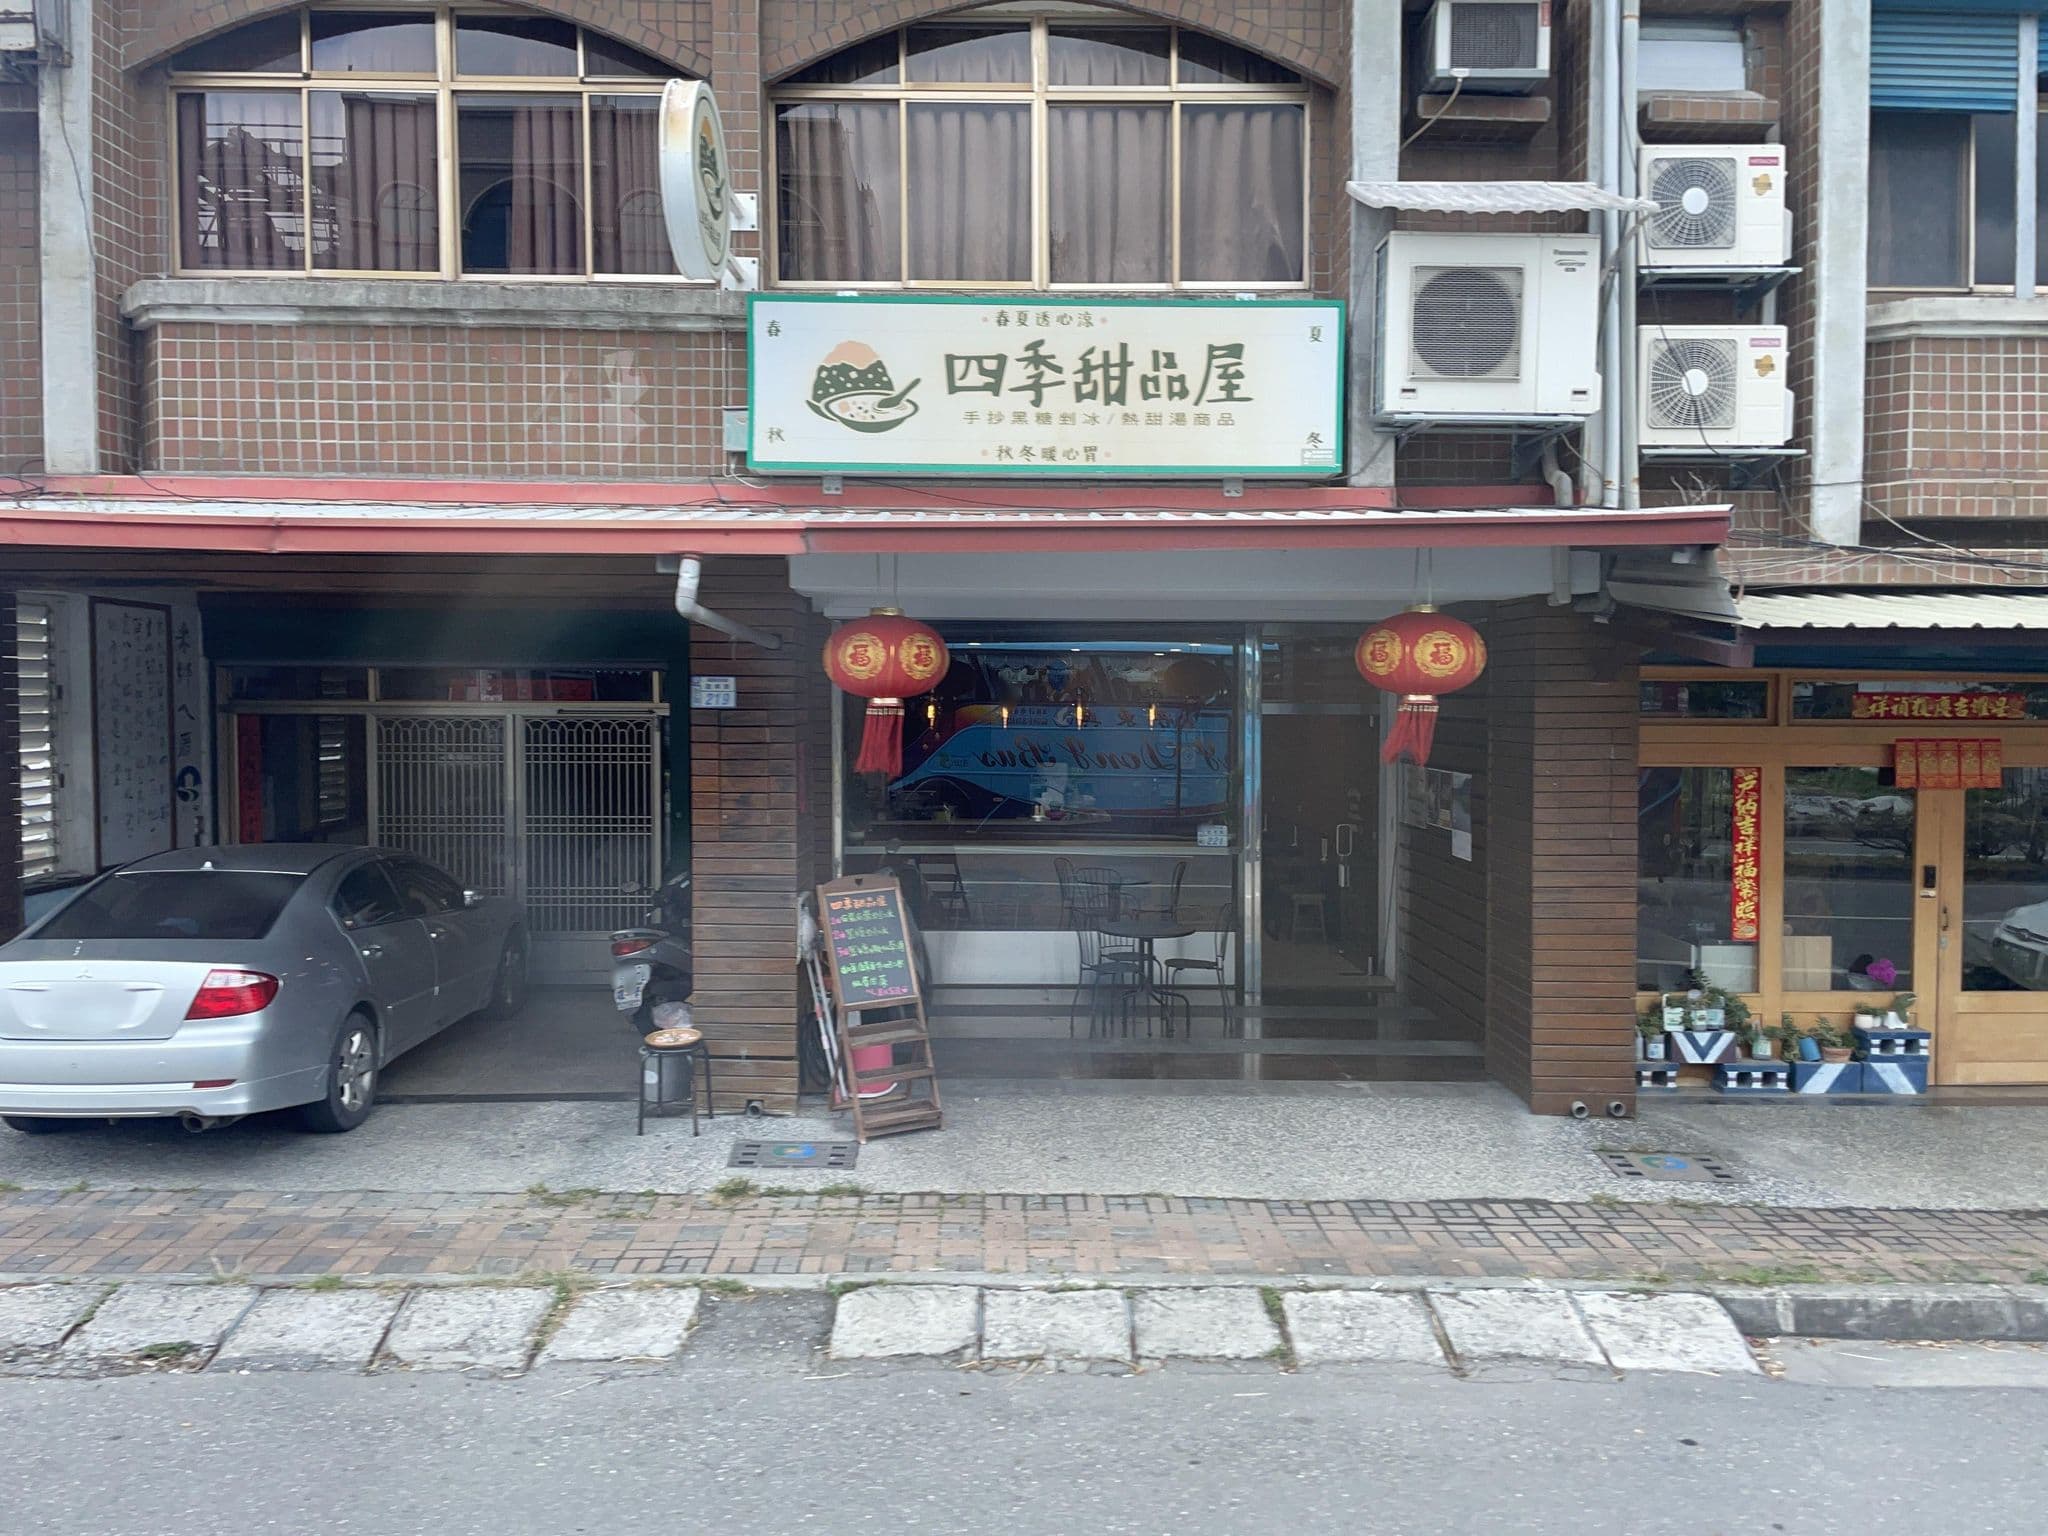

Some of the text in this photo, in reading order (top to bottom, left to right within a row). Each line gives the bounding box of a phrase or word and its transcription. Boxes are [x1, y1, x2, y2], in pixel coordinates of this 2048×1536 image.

[766, 319, 782, 337] 春
[995, 310, 1094, 328] 春夏透心涼
[1308, 325, 1323, 343] 夏
[944, 338, 1254, 408] 四季甜品屋
[767, 427, 785, 443] 秋
[1306, 431, 1324, 449] 冬
[995, 444, 1100, 463] 秋冬暖心胃
[704, 693, 730, 706] 219
